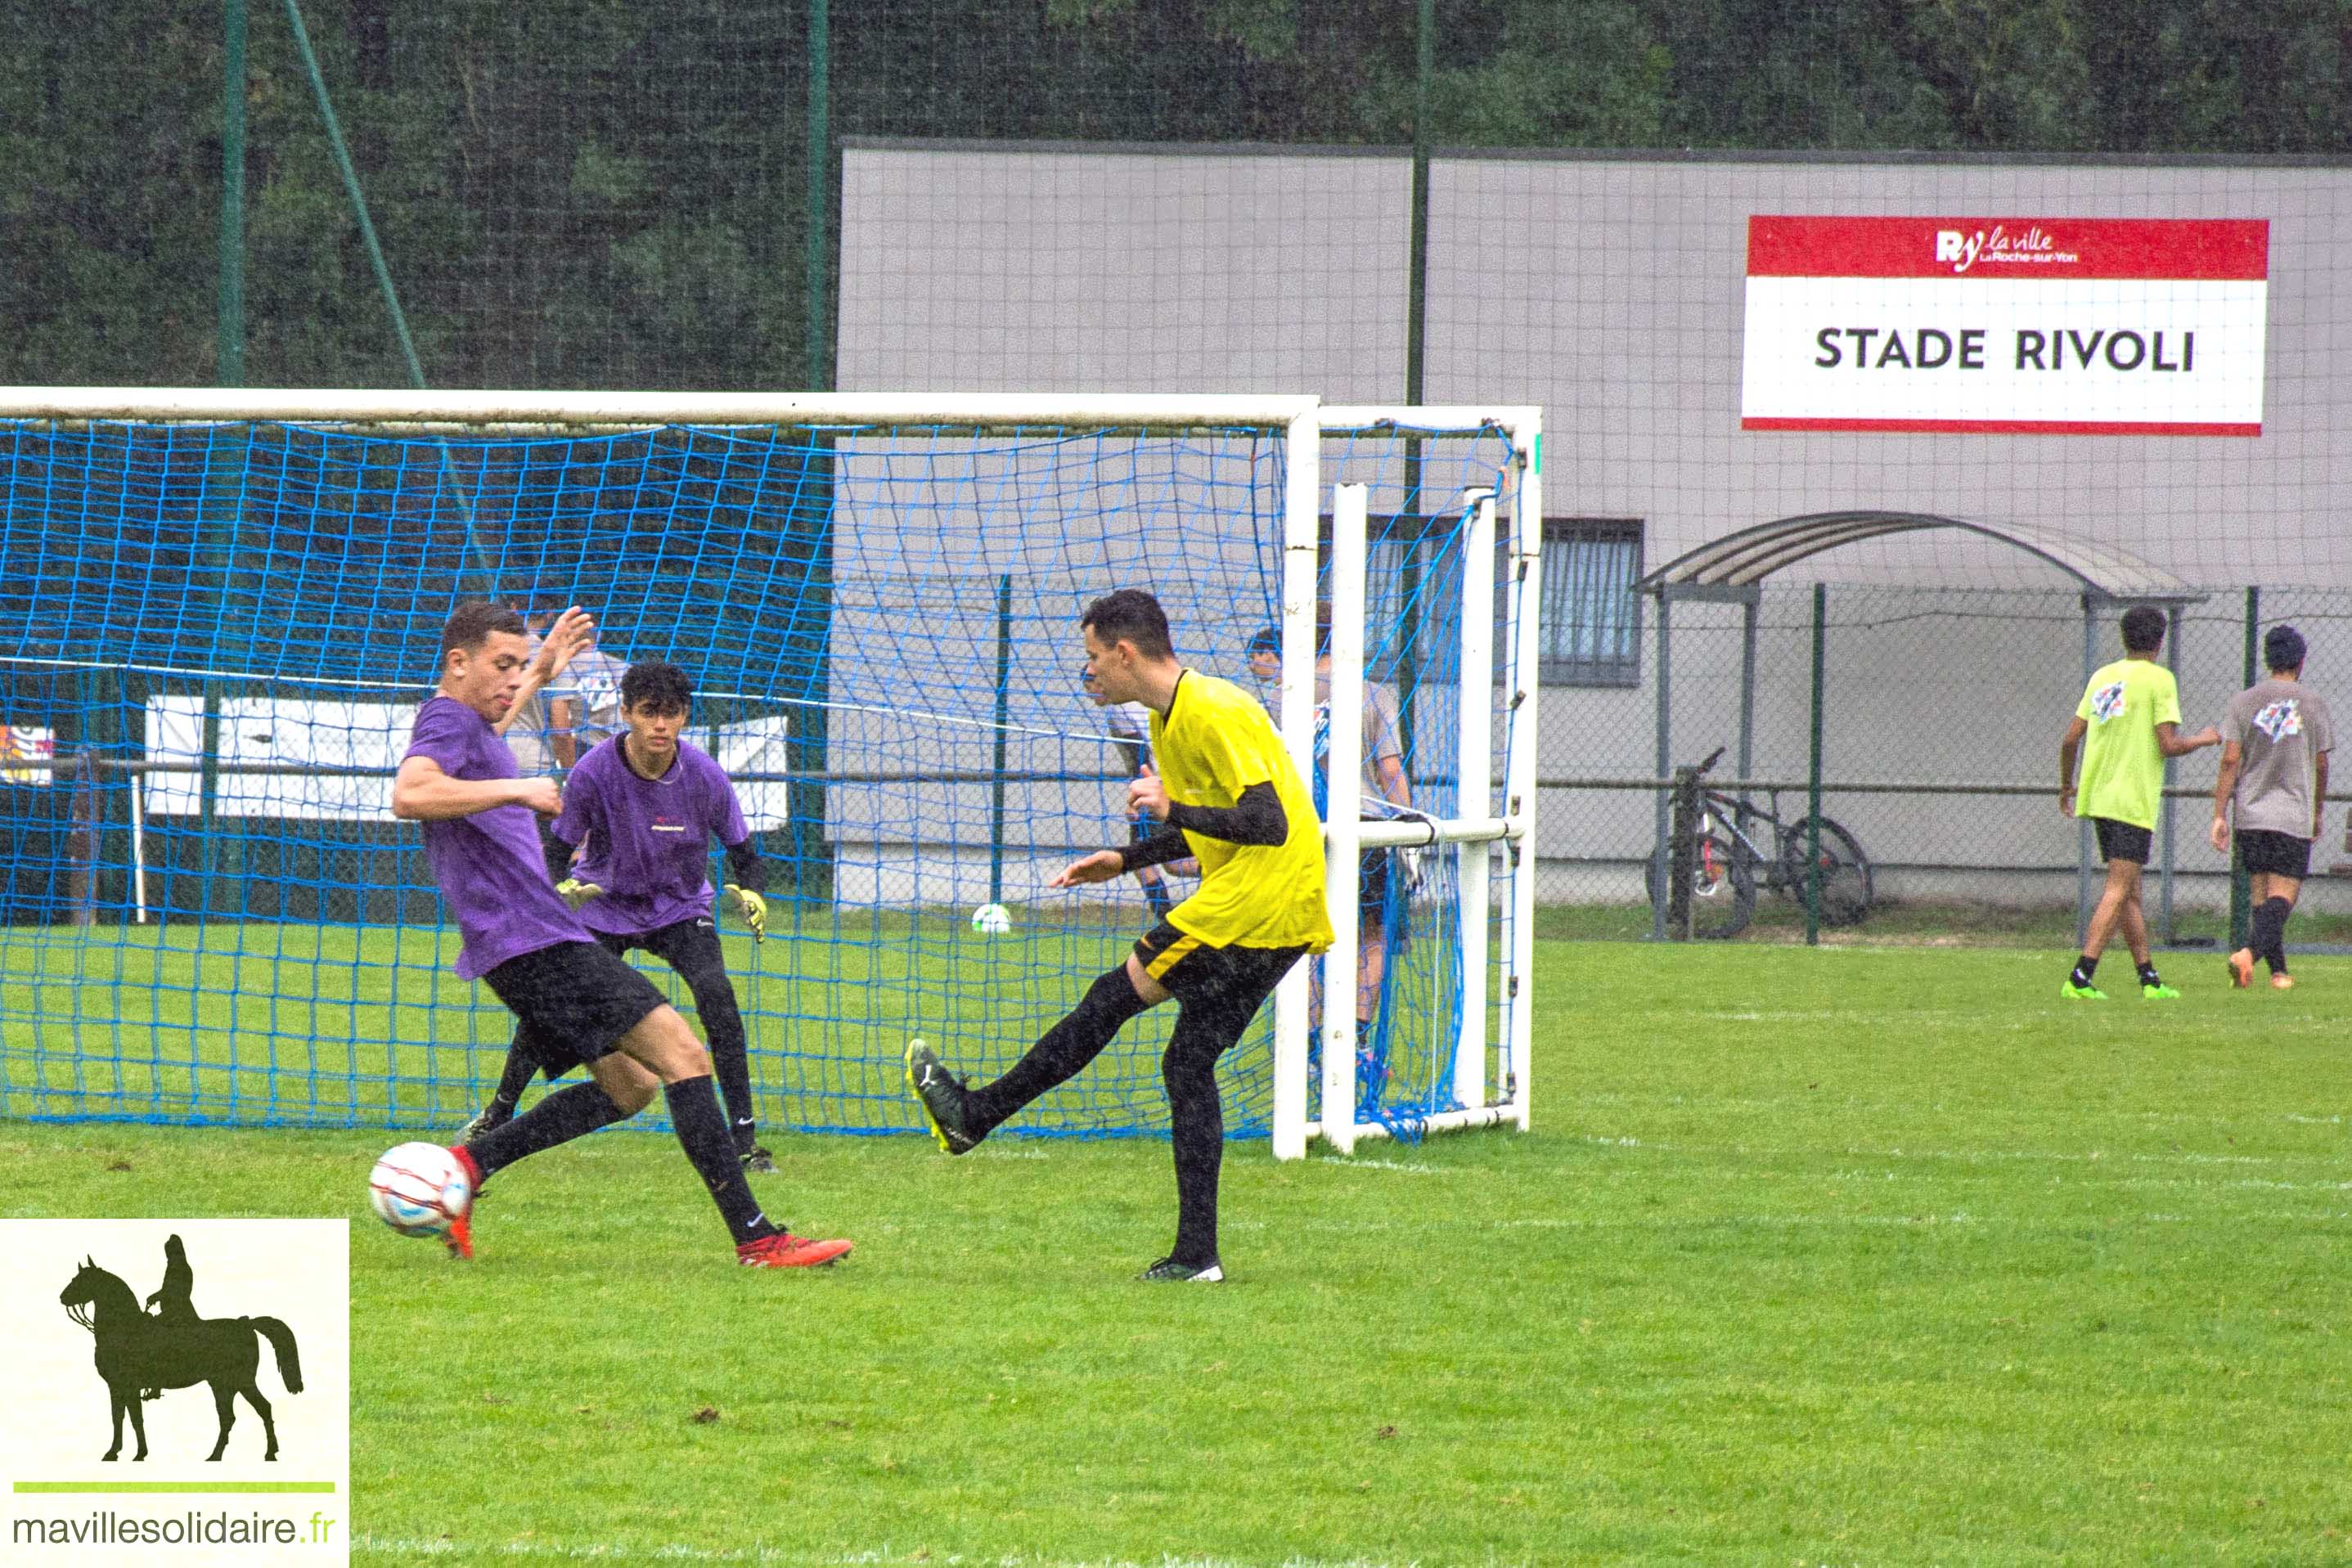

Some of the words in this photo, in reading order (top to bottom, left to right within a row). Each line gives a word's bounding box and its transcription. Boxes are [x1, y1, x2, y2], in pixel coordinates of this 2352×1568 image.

[1985, 225, 2009, 250] la
[2012, 227, 2053, 250] ville
[1815, 327, 1985, 369] STADE
[2016, 329, 2193, 371] RIVOLI
